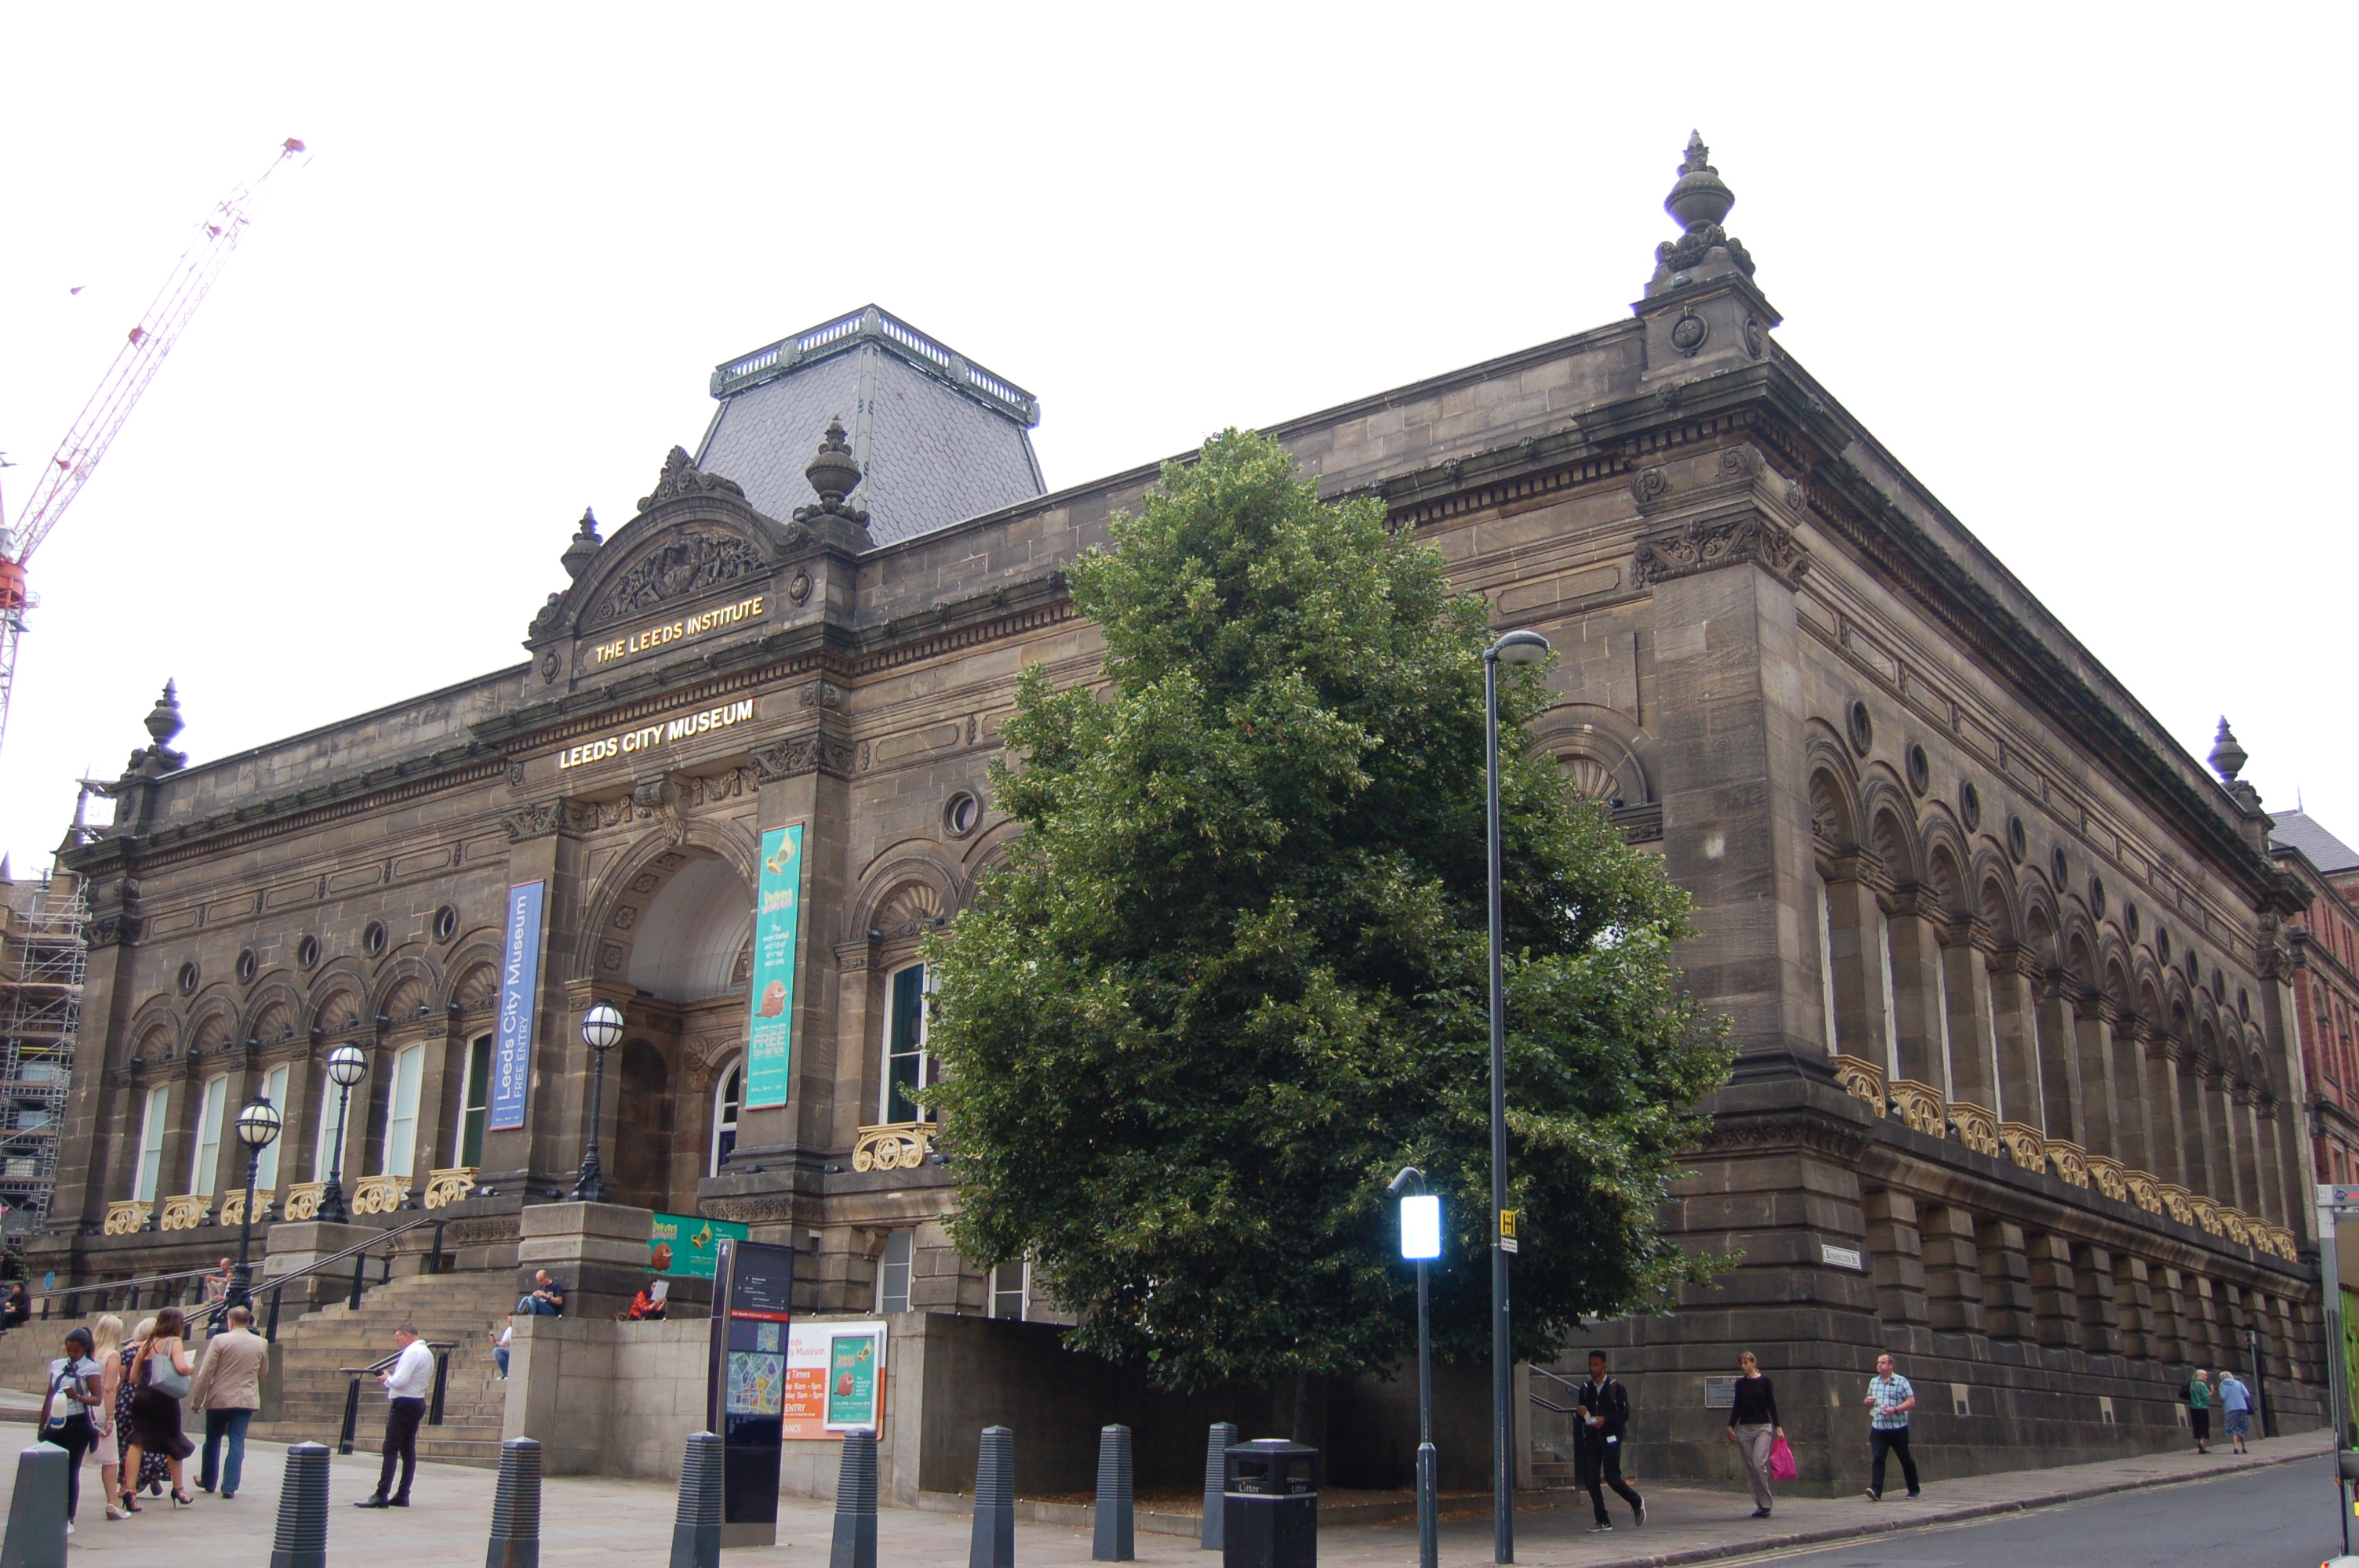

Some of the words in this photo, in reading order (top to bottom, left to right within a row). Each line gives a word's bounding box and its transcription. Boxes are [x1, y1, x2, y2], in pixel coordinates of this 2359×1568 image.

[596, 640, 625, 663] THE
[630, 622, 683, 653] LEEDS
[687, 596, 764, 636] INSTITUTE
[560, 737, 618, 769] LEEDS
[623, 724, 665, 752] CITY
[668, 698, 755, 741] MUSEUM
[507, 895, 527, 985] Museum
[503, 992, 522, 1033] City
[518, 1015, 529, 1061] ENTRY
[754, 1031, 787, 1049] FREE
[497, 1040, 515, 1101] Leeds
[514, 1064, 525, 1098] FREE
[796, 1347, 825, 1356] Museum
[792, 1370, 811, 1379] Times
[785, 1403, 806, 1412] ENTRY
[1239, 1483, 1259, 1493] Litter
